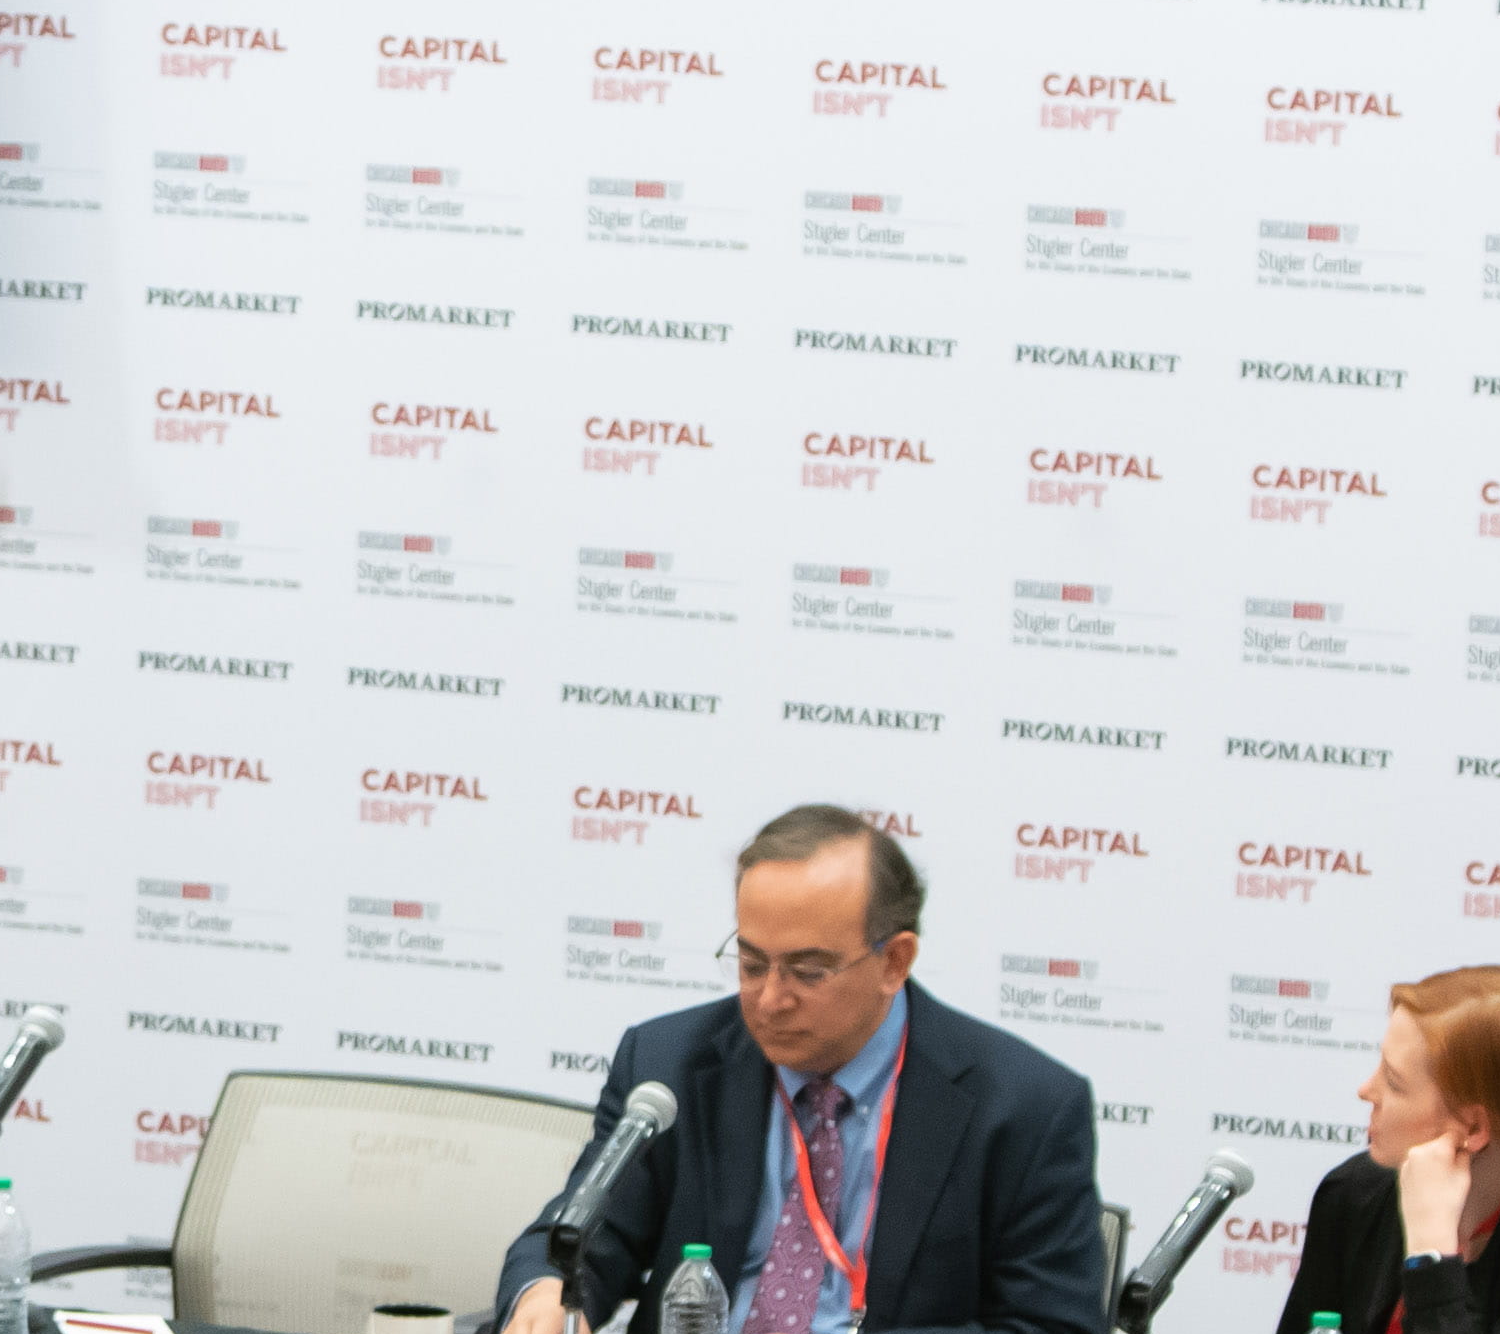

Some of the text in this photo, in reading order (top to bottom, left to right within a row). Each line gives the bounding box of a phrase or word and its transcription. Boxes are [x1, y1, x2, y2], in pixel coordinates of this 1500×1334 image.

[159, 21, 289, 54] CAPITAL
[377, 33, 509, 66] CAPITAL
[592, 45, 725, 78] CAPITAL
[813, 58, 949, 92] CAPITAL
[1040, 71, 1177, 106] CAPITAL
[1264, 85, 1404, 120] CAPITAL
[144, 287, 301, 316] PROMARKET
[355, 300, 514, 329] PROMARKET
[570, 314, 731, 344] PROMARKET
[792, 328, 957, 359] PROMARKET
[1013, 343, 1180, 375] PROMARKET
[1238, 359, 1407, 390] PROMARKET
[154, 386, 283, 420] CAPITAL
[369, 400, 500, 435] CAPITAL
[582, 415, 715, 450] CAPITAL
[801, 430, 937, 466] CAPITAL
[1027, 446, 1165, 483] CAPITAL
[1250, 462, 1389, 499] CAPITAL
[136, 650, 293, 681] PROMARKET
[345, 666, 505, 698] PROMARKET
[559, 683, 722, 715] PROMARKET
[780, 700, 944, 733] PROMARKET
[1000, 718, 1167, 752] PROMARKET
[145, 749, 273, 785] CAPITAL
[1223, 736, 1392, 770] PROMARKET
[359, 766, 490, 803] CAPITAL
[571, 784, 704, 821] CAPITAL
[1014, 821, 1151, 859] CAPITAL
[1235, 840, 1374, 878] CAPITAL
[125, 1010, 282, 1044] PROMARKET
[334, 1029, 495, 1064] PROMARKET
